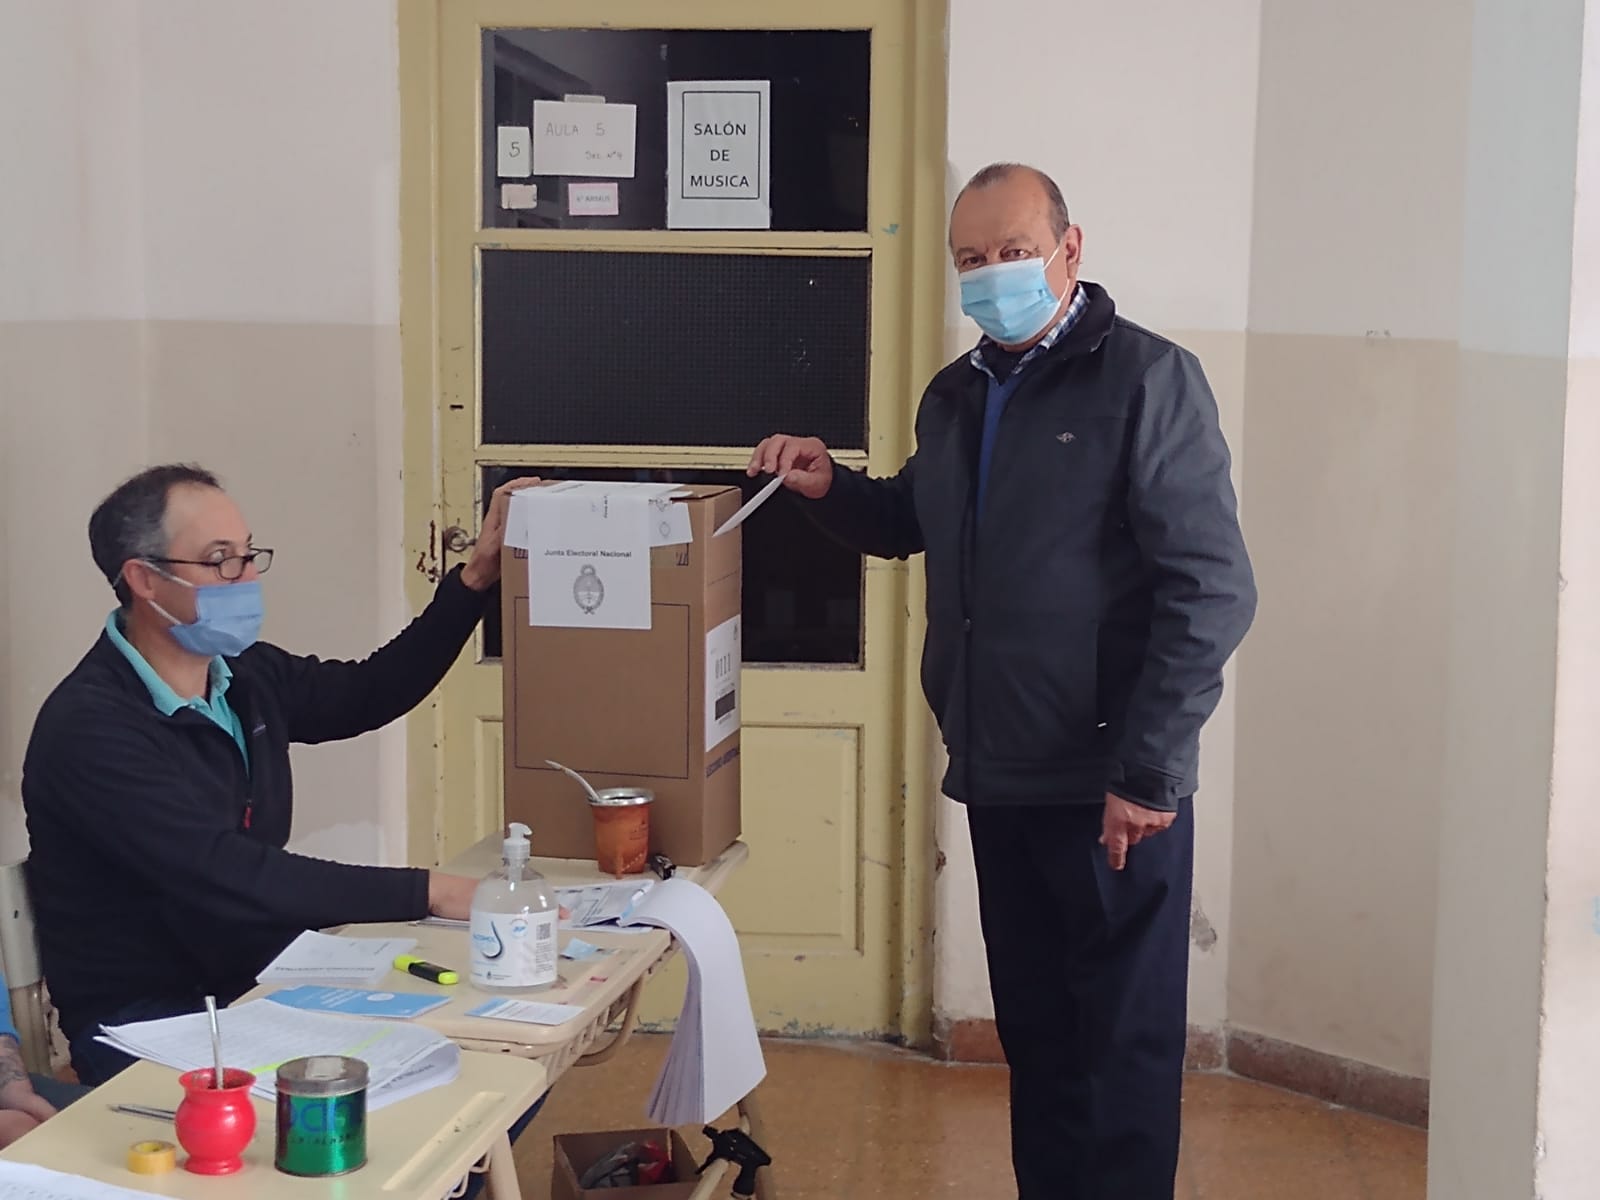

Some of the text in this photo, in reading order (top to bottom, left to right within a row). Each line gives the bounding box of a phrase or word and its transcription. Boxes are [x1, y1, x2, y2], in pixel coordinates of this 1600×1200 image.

[546, 122, 606, 137] AULA 5
[693, 122, 747, 137] SALÓN
[509, 141, 521, 158] 5
[710, 150, 730, 162] DE
[690, 175, 750, 188] MUSICA
[544, 549, 632, 558] Junta Electoral Nacional
